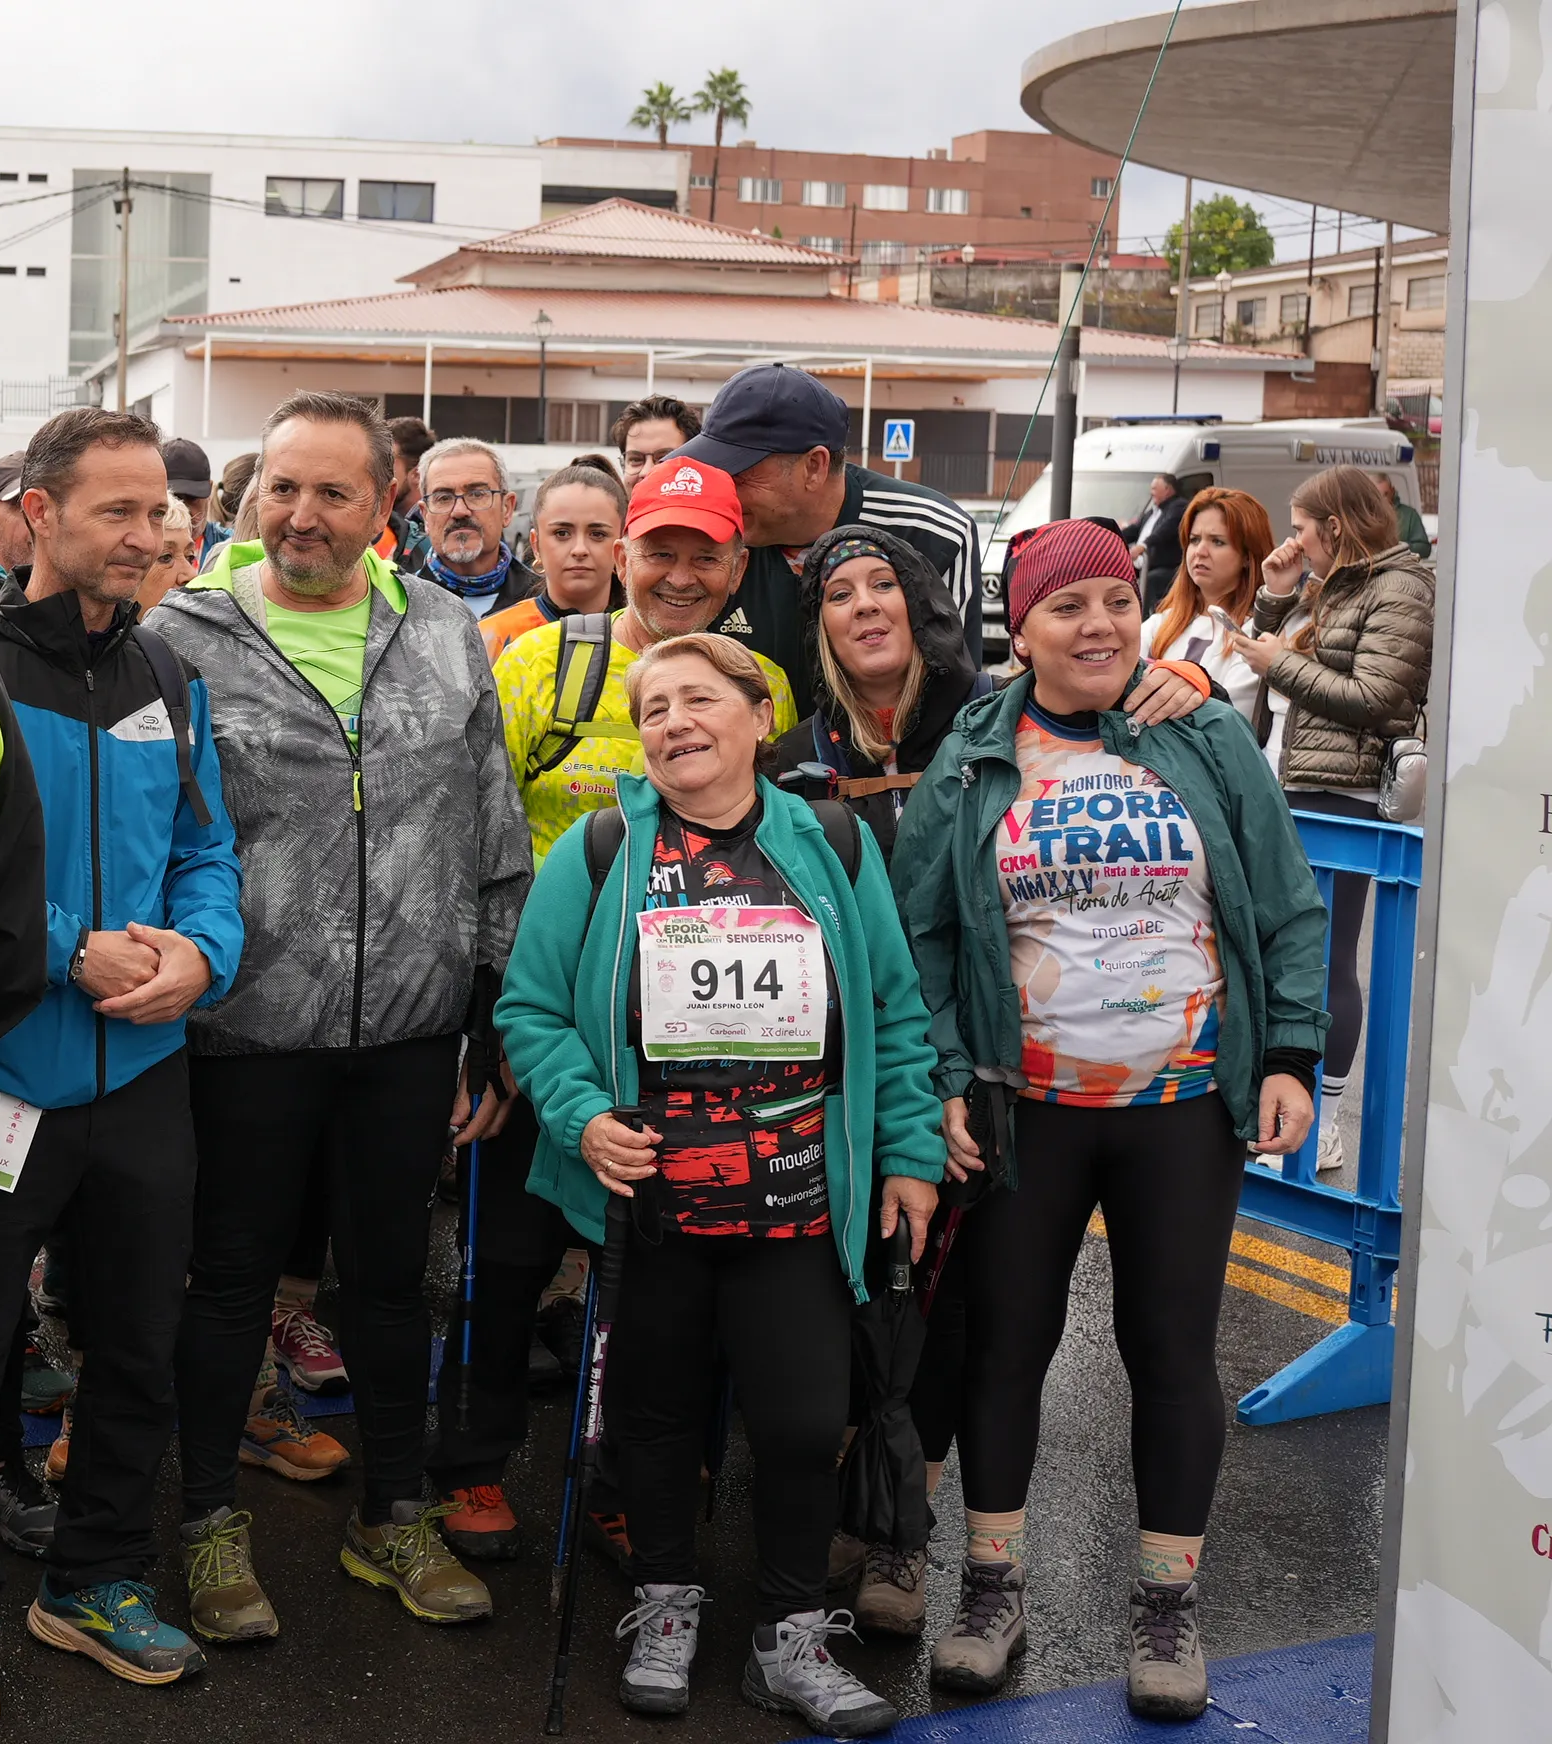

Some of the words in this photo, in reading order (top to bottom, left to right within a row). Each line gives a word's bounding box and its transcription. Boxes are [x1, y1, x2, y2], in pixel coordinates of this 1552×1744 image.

[1351, 449, 1391, 466] MOVIL
[660, 481, 702, 493] OASYS
[720, 623, 753, 634] adidas
[573, 763, 594, 771] EAS
[1062, 774, 1133, 795] MONTORO
[1029, 790, 1188, 829] EPORA
[1028, 822, 1194, 867] TRAIL
[999, 854, 1037, 873] CXM
[1104, 867, 1127, 877] Ruta
[1130, 866, 1140, 877] de
[1144, 865, 1189, 877] Senderismo
[1006, 868, 1094, 902] MMXXV
[1050, 888, 1109, 914] Tierra
[1111, 881, 1129, 908] de
[664, 924, 708, 934] EPORA
[667, 934, 704, 944] TRAIL
[726, 934, 805, 943] SENDERISMO
[690, 959, 783, 1000] 914
[709, 1028, 746, 1036] Carbonell
[775, 1027, 812, 1037] direlux
